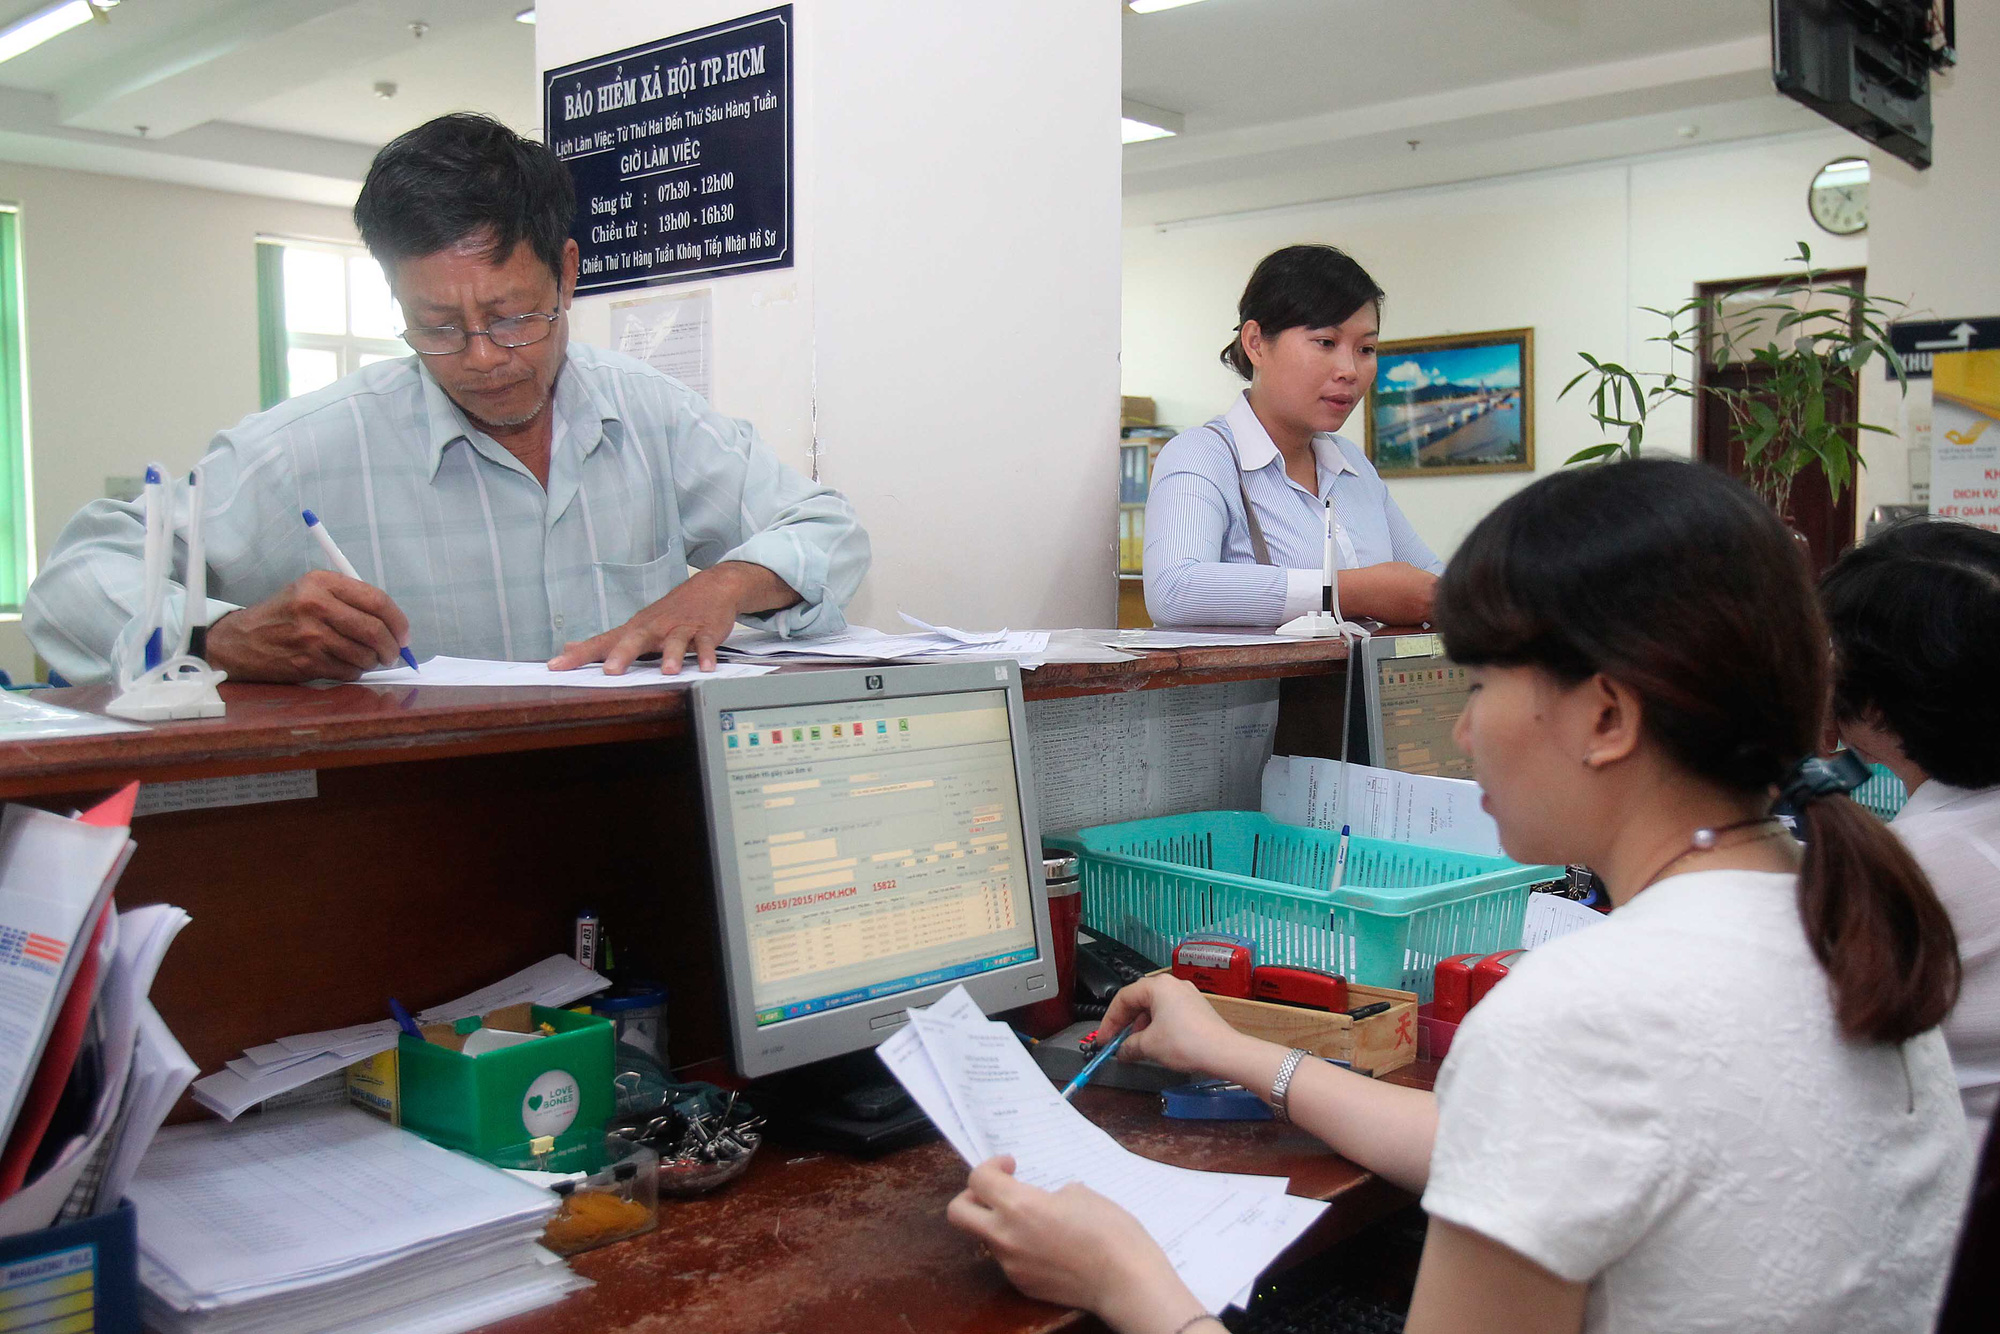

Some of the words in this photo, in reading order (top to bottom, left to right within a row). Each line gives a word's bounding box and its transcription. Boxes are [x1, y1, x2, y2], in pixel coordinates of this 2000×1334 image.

[565, 82, 593, 121] BẢO
[598, 66, 636, 113] HIỂM
[640, 65, 663, 102] XÃ
[668, 58, 696, 99] HỘI
[701, 46, 766, 87] TP.HCM
[556, 140, 572, 158] Lịch
[575, 136, 592, 152] Làm
[594, 131, 615, 149] Việc:
[617, 126, 629, 142] Từ
[630, 122, 647, 140] Thứ
[648, 118, 662, 135] Hai
[665, 112, 682, 132] Đến
[685, 108, 703, 127] Thứ
[705, 105, 723, 123] Sáu
[726, 100, 750, 119] Hàng
[753, 90, 777, 112] Tuần
[621, 149, 641, 174] GIỜ
[644, 144, 668, 169] LÀM
[672, 137, 700, 164] VIỆC
[591, 196, 617, 215] Sáng
[620, 192, 632, 209] từ
[658, 181, 690, 202] 07h30
[701, 172, 734, 194] 12h00
[592, 221, 622, 243] Chiều
[626, 220, 638, 238] từ
[659, 211, 690, 232] 13h00
[701, 203, 734, 225] 16h30
[582, 255, 602, 274] Chiều
[605, 254, 619, 271] Thứ
[621, 252, 631, 268] Tư
[633, 250, 652, 268] Hàng
[655, 243, 674, 263] Tuần
[677, 243, 701, 260] Không
[704, 235, 722, 258] Tiếp
[726, 235, 746, 254] Nhận
[750, 228, 761, 249] Hồ
[765, 230, 776, 246] Sơ
[756, 887, 857, 914] 166519/2015/HCM.HCM
[873, 880, 897, 892] 15822
[544, 1094, 573, 1108] BONES
[550, 1085, 572, 1098] LOVE
